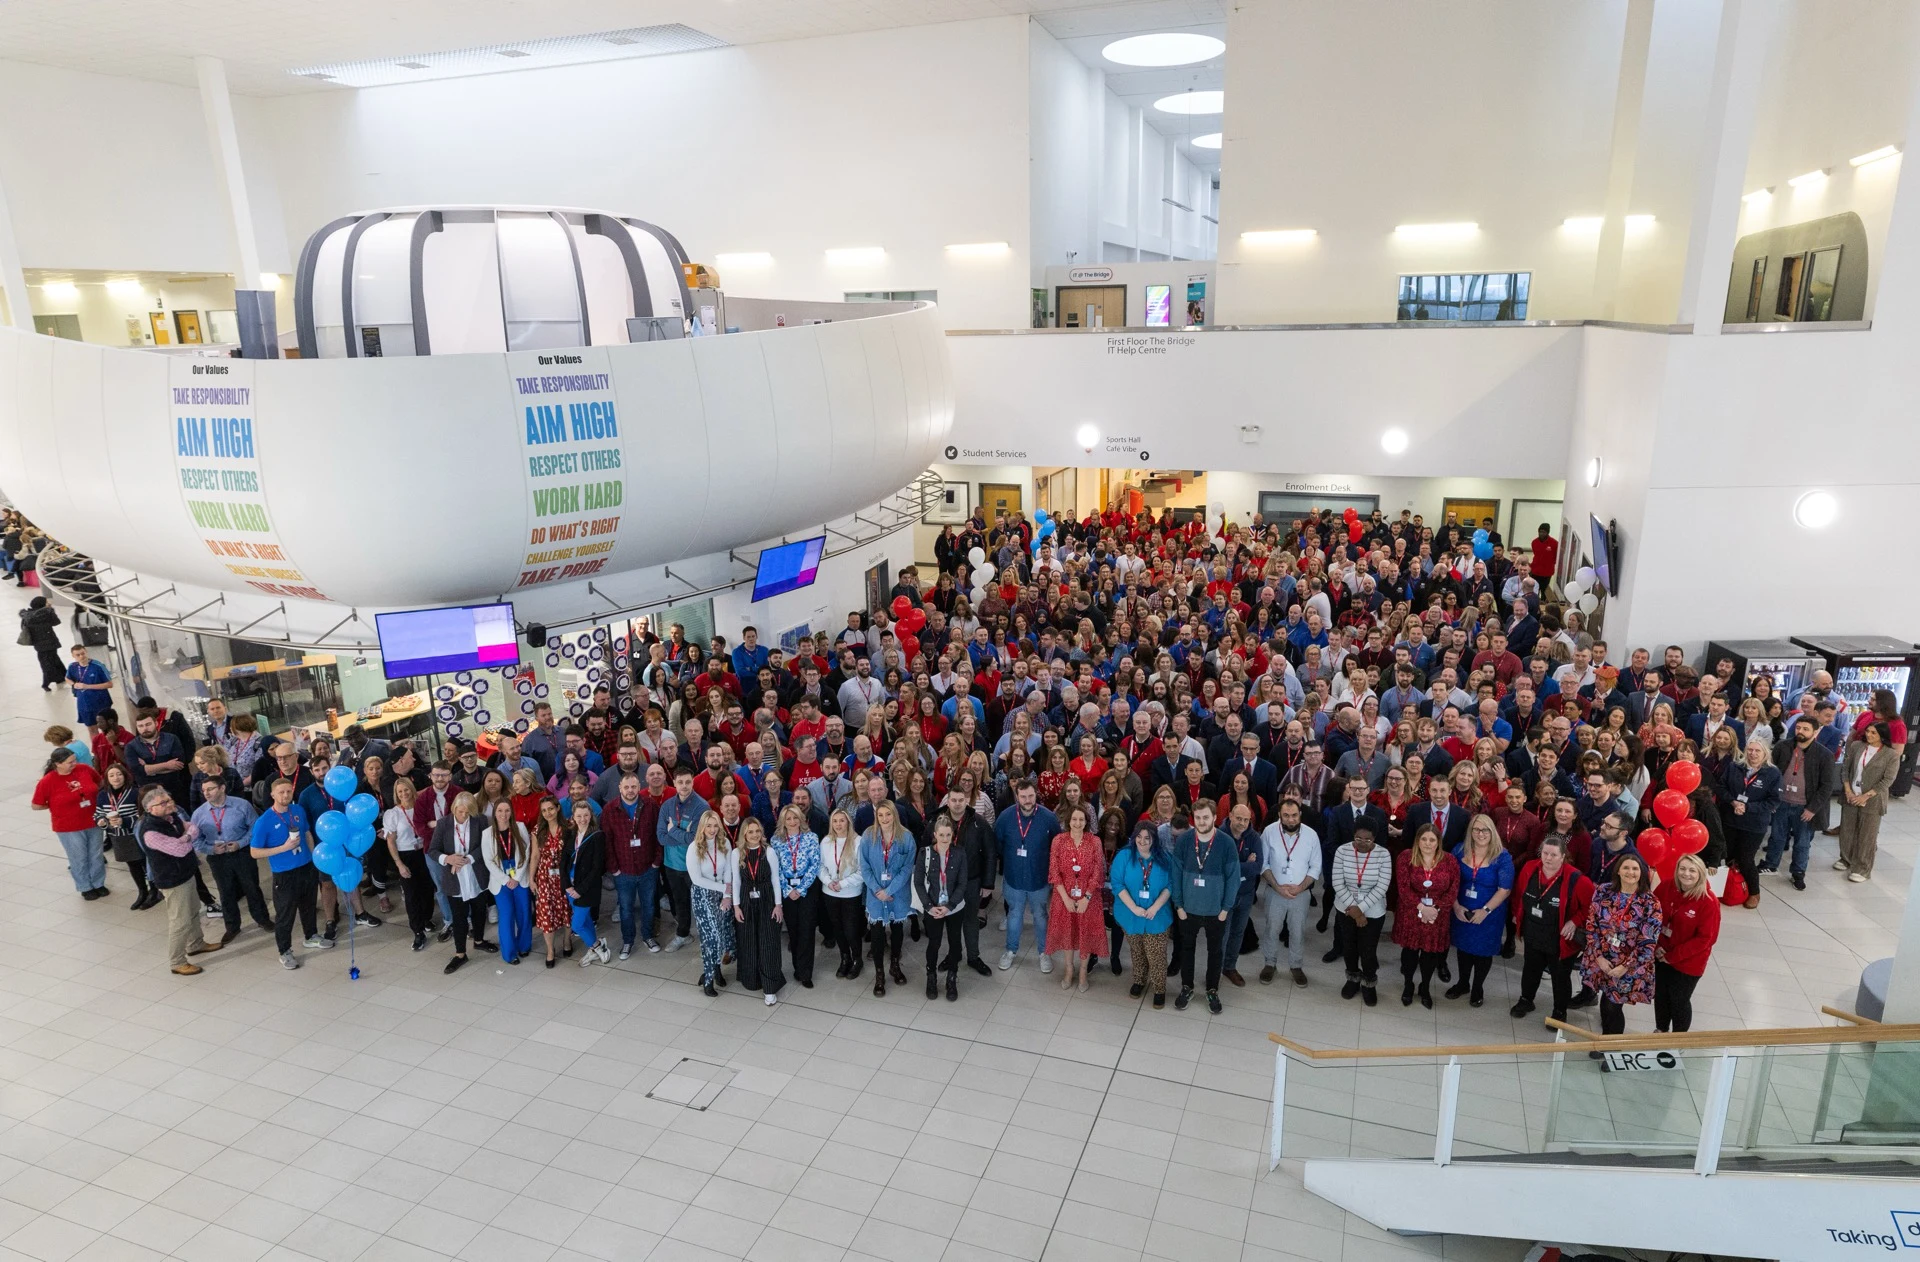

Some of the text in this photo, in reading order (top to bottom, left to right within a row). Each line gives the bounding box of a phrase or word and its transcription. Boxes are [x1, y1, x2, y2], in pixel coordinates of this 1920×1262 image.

[1108, 338, 1124, 346] First
[1126, 337, 1148, 345] Floor
[1167, 336, 1196, 346] Bridge
[1117, 346, 1136, 356] Help
[1138, 346, 1166, 354] Centre
[192, 365, 228, 374] Our Values
[538, 354, 582, 365] Our Values
[516, 374, 609, 394] TAKE RESPONSIBILITY
[173, 388, 250, 405] TAKE RESPONSIBILITY
[526, 401, 618, 445] AIM HIGH
[178, 417, 254, 458] AIM HIGH
[529, 449, 621, 477] RESPECT OTHERS
[962, 449, 993, 457] Student
[181, 468, 258, 492] RESPECT OTHERS
[1286, 482, 1352, 492] Enrolment Desk
[533, 480, 622, 517] WORK HARD
[188, 500, 270, 532] WORK HARD
[530, 516, 620, 545] DO WHAT'S RIGHT
[205, 539, 286, 561] DO WHAT'S RIGHT
[526, 540, 616, 565] CHALLENGE YOURSELF
[518, 558, 608, 587] TAKE PRIDE
[1610, 1053, 1651, 1070] LRC
[1826, 1228, 1897, 1251] Taking
